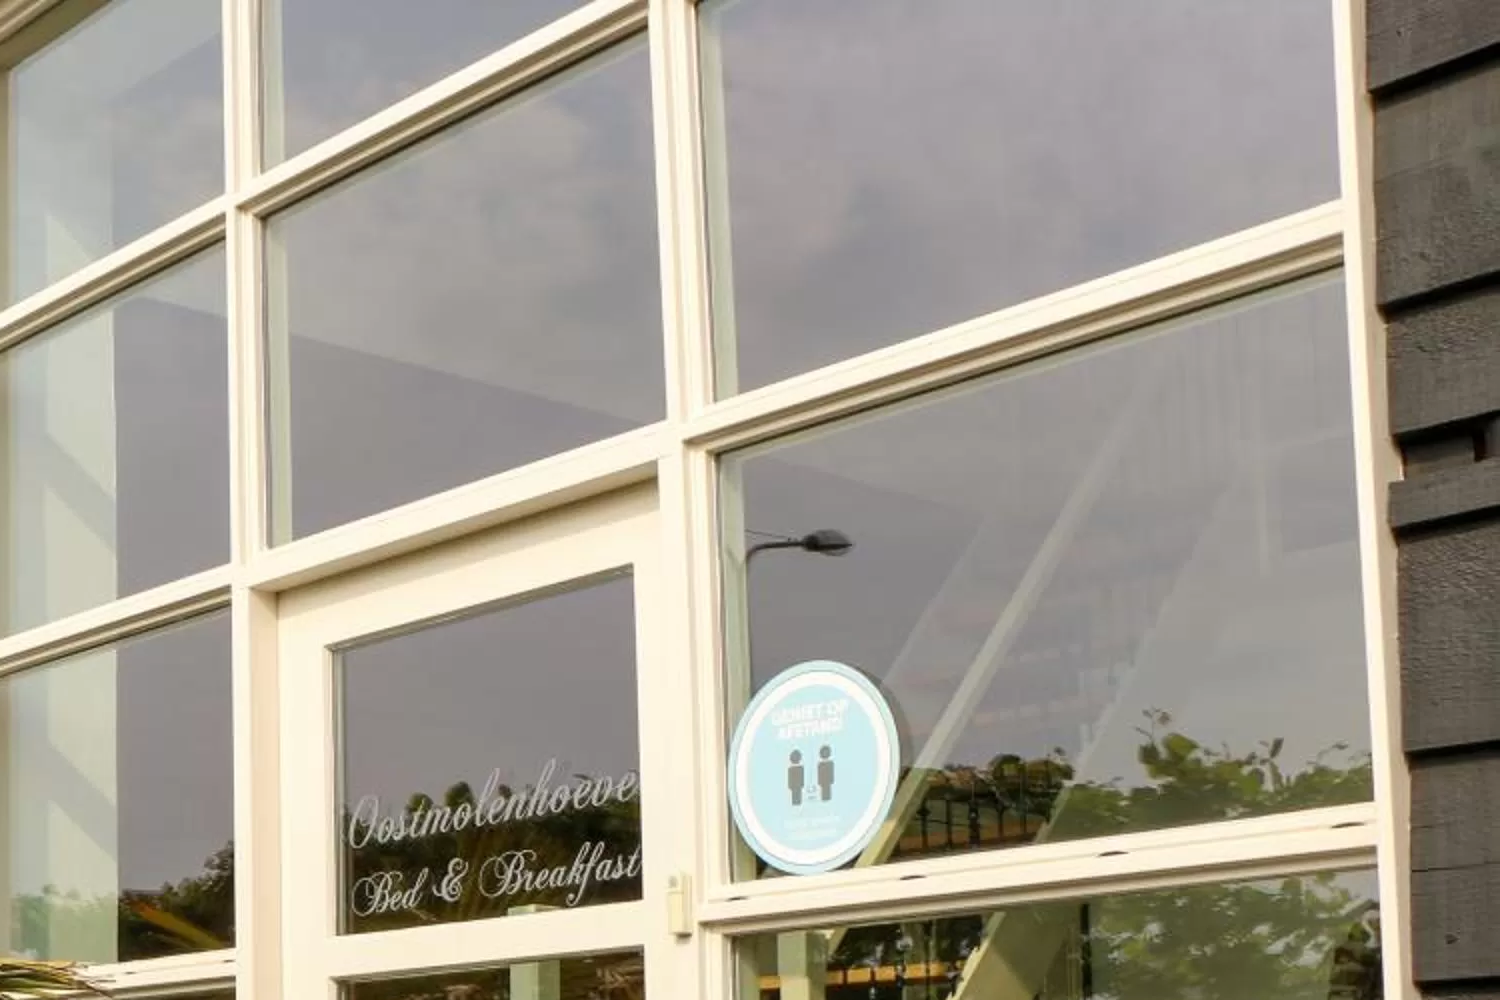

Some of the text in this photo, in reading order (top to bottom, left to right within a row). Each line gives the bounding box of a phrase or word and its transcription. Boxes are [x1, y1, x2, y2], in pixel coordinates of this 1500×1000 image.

[350, 758, 638, 848] Oostmolenhoeve
[352, 841, 641, 917] Bed & Breakfast
